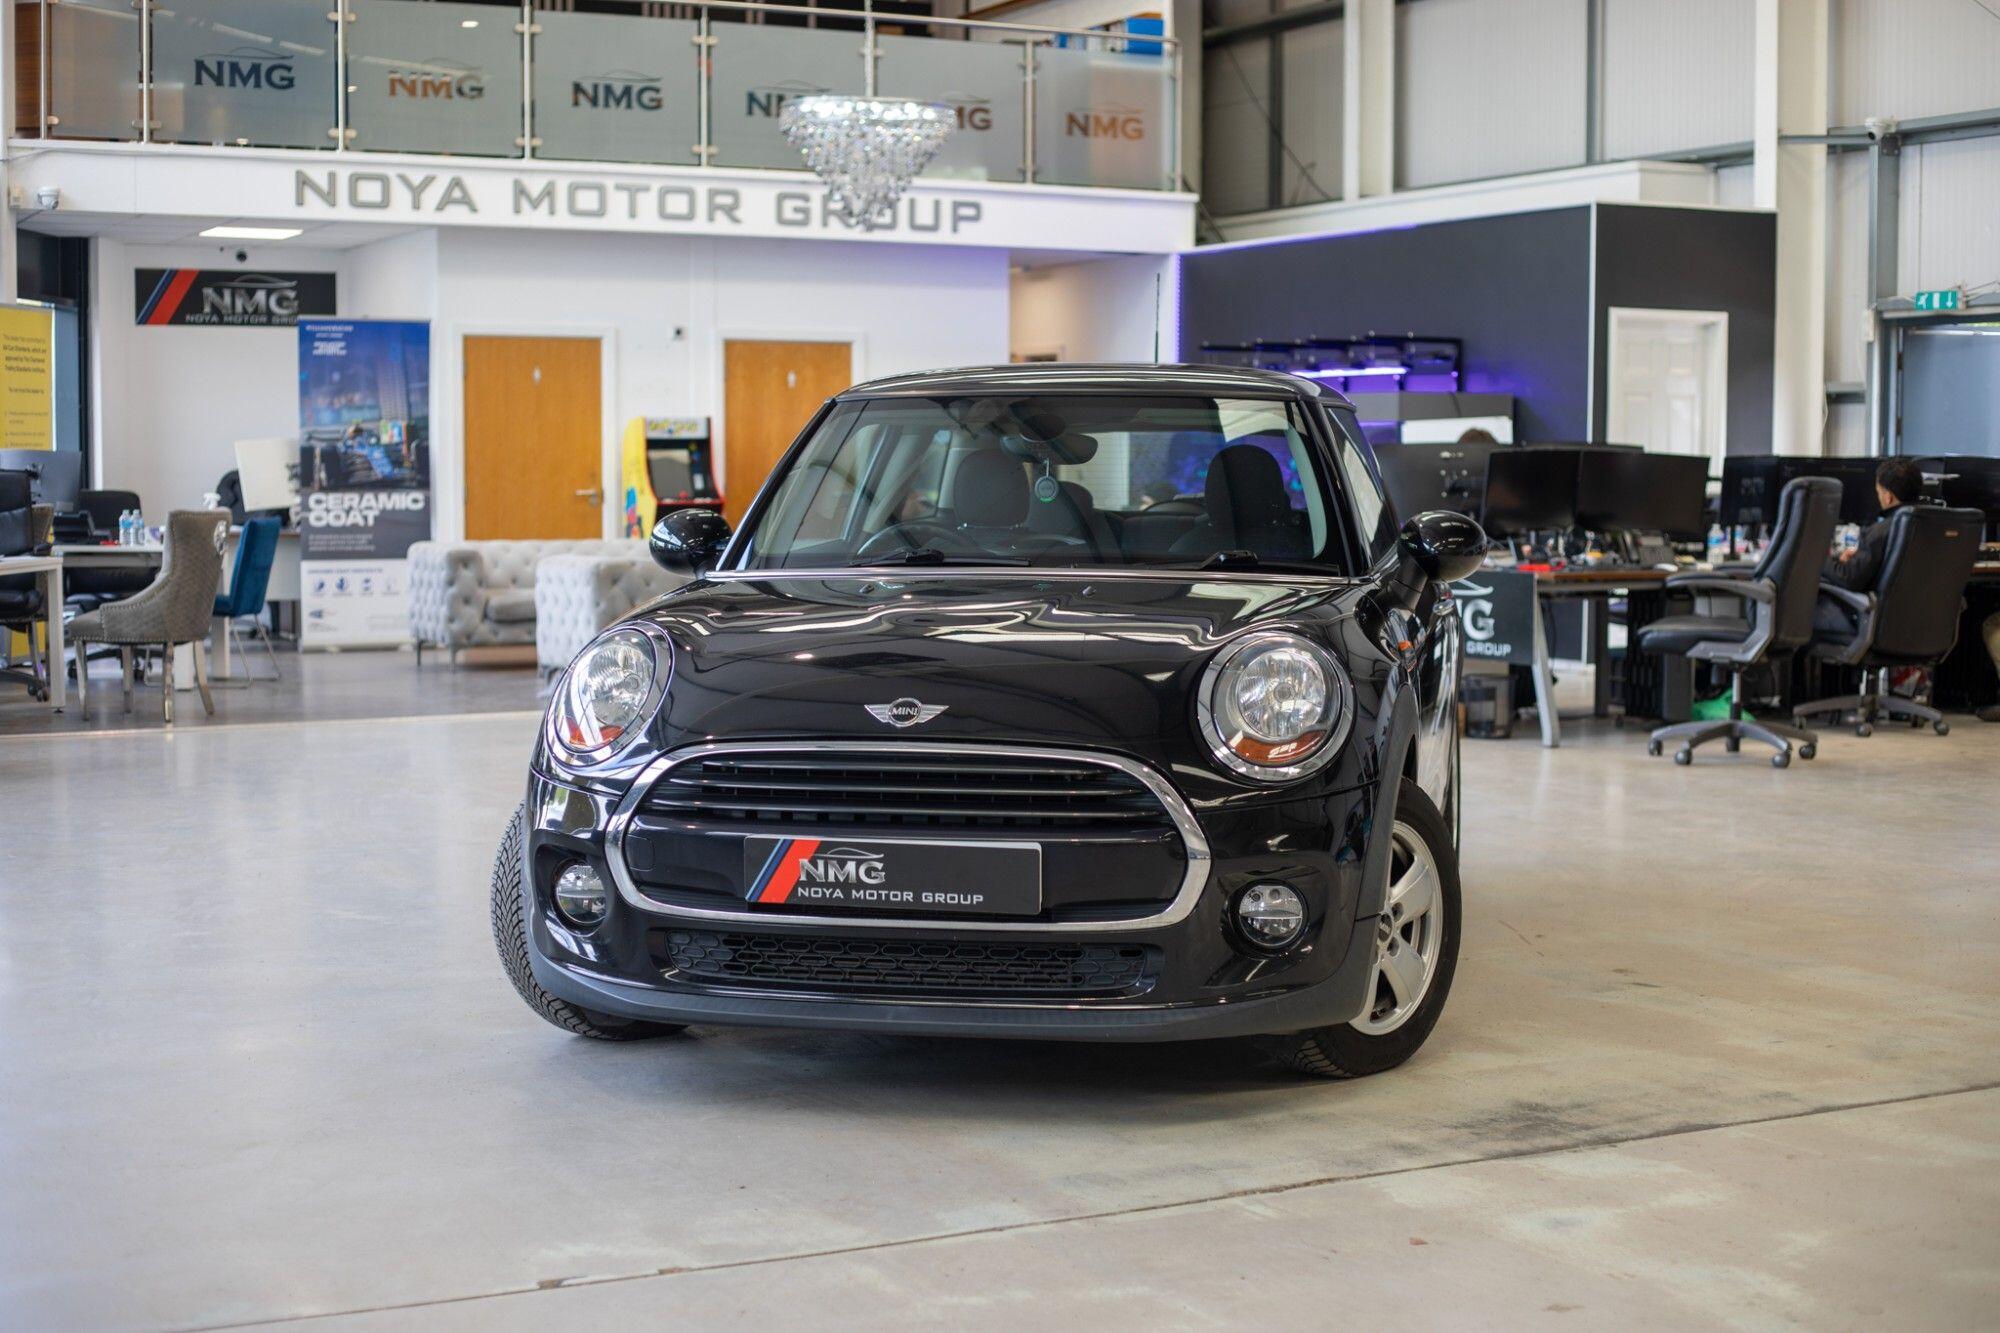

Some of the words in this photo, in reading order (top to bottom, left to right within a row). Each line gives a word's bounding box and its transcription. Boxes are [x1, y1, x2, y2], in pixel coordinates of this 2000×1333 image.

[194, 59, 295, 91] NMG
[388, 70, 484, 100] NMG
[572, 82, 663, 111] NMG
[1065, 112, 1144, 140] NMG
[295, 170, 478, 213] NOYA
[513, 178, 742, 224] MOTOR
[202, 286, 299, 315] NMG
[308, 492, 425, 511] CERAMIC
[308, 510, 380, 527] COAT
[1466, 641, 1511, 656] GROUP
[891, 707, 917, 715] MINI
[799, 859, 885, 884] NMG
[798, 887, 844, 899] NOYA
[851, 890, 914, 902] MOTOR
[922, 892, 983, 905] GROUP
